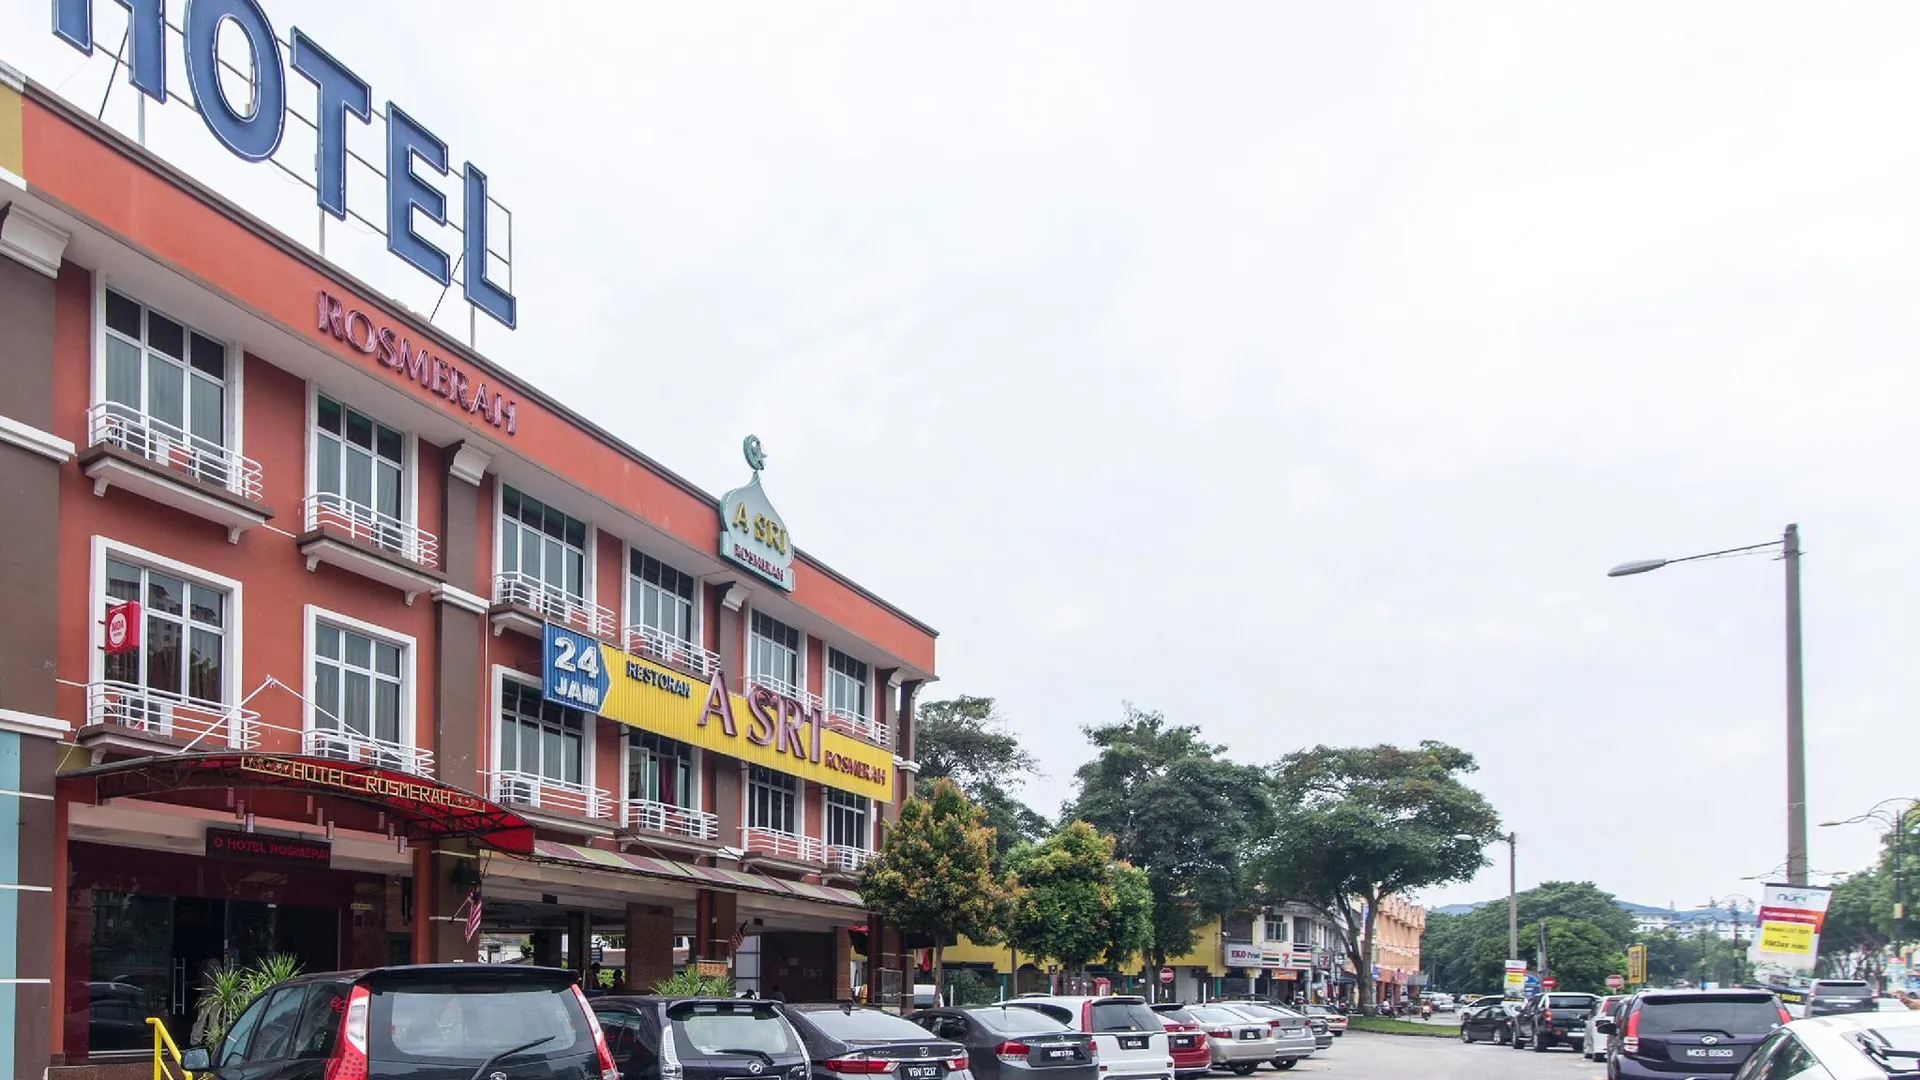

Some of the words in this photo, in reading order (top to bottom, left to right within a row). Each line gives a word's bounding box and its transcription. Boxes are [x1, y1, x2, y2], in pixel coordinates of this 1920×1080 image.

[316, 290, 517, 436] ROSMERAH
[732, 502, 749, 533] A
[753, 512, 786, 555] SRI
[554, 636, 599, 679] 24
[554, 676, 599, 706] JAM
[626, 660, 691, 698] RESTORAN
[697, 669, 738, 737] A
[746, 685, 822, 763] SRI
[824, 749, 887, 786] ROSMERAH
[293, 761, 357, 789] HOTEL
[365, 775, 450, 805] ROSMERAH
[227, 838, 266, 853] HOTEL
